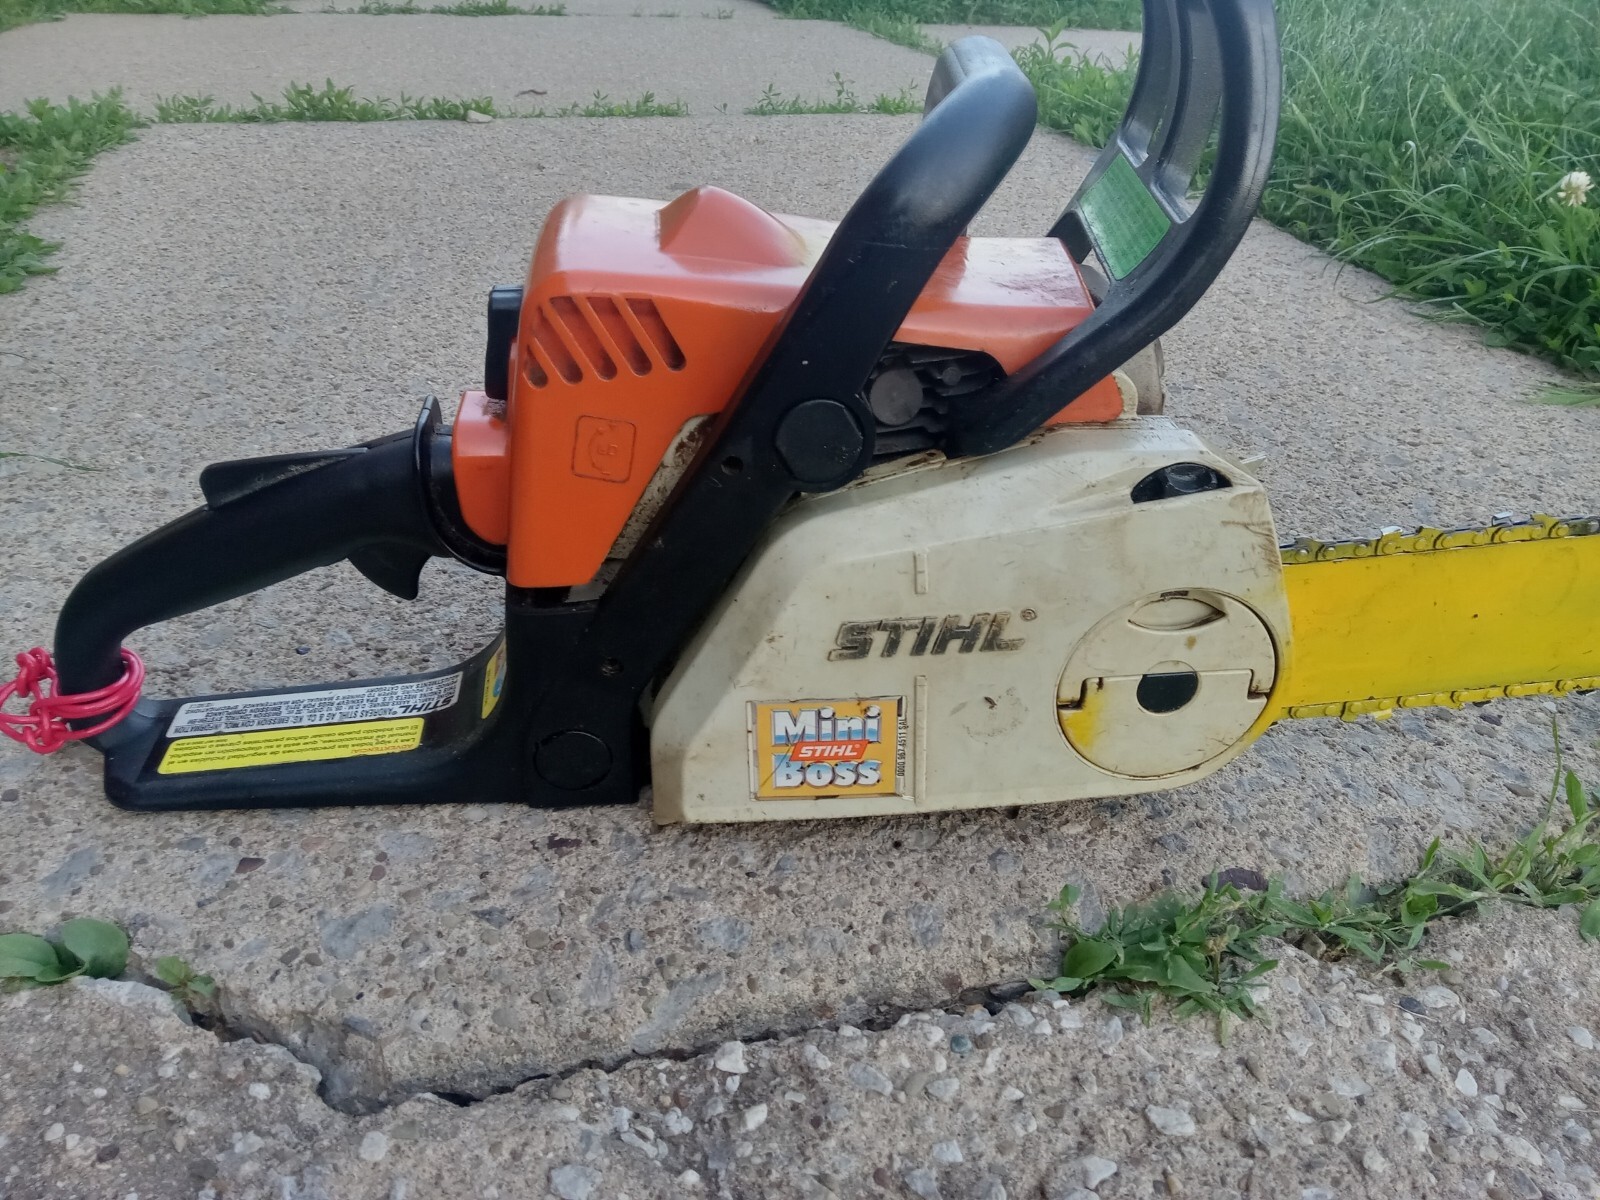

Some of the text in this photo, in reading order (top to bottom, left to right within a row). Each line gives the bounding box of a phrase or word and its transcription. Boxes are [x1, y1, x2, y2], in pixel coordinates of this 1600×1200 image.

[205, 708, 247, 717] COMPLIANCE
[249, 705, 281, 713] EMISSION
[359, 706, 392, 717] ANDREAS
[325, 712, 336, 720] AG
[338, 710, 357, 719] STIHL
[224, 719, 254, 729] CONTROL
[257, 716, 289, 726] EMISSION
[173, 723, 221, 734] INFORMATION
[771, 705, 882, 747] Mini
[226, 751, 268, 759] seguridad
